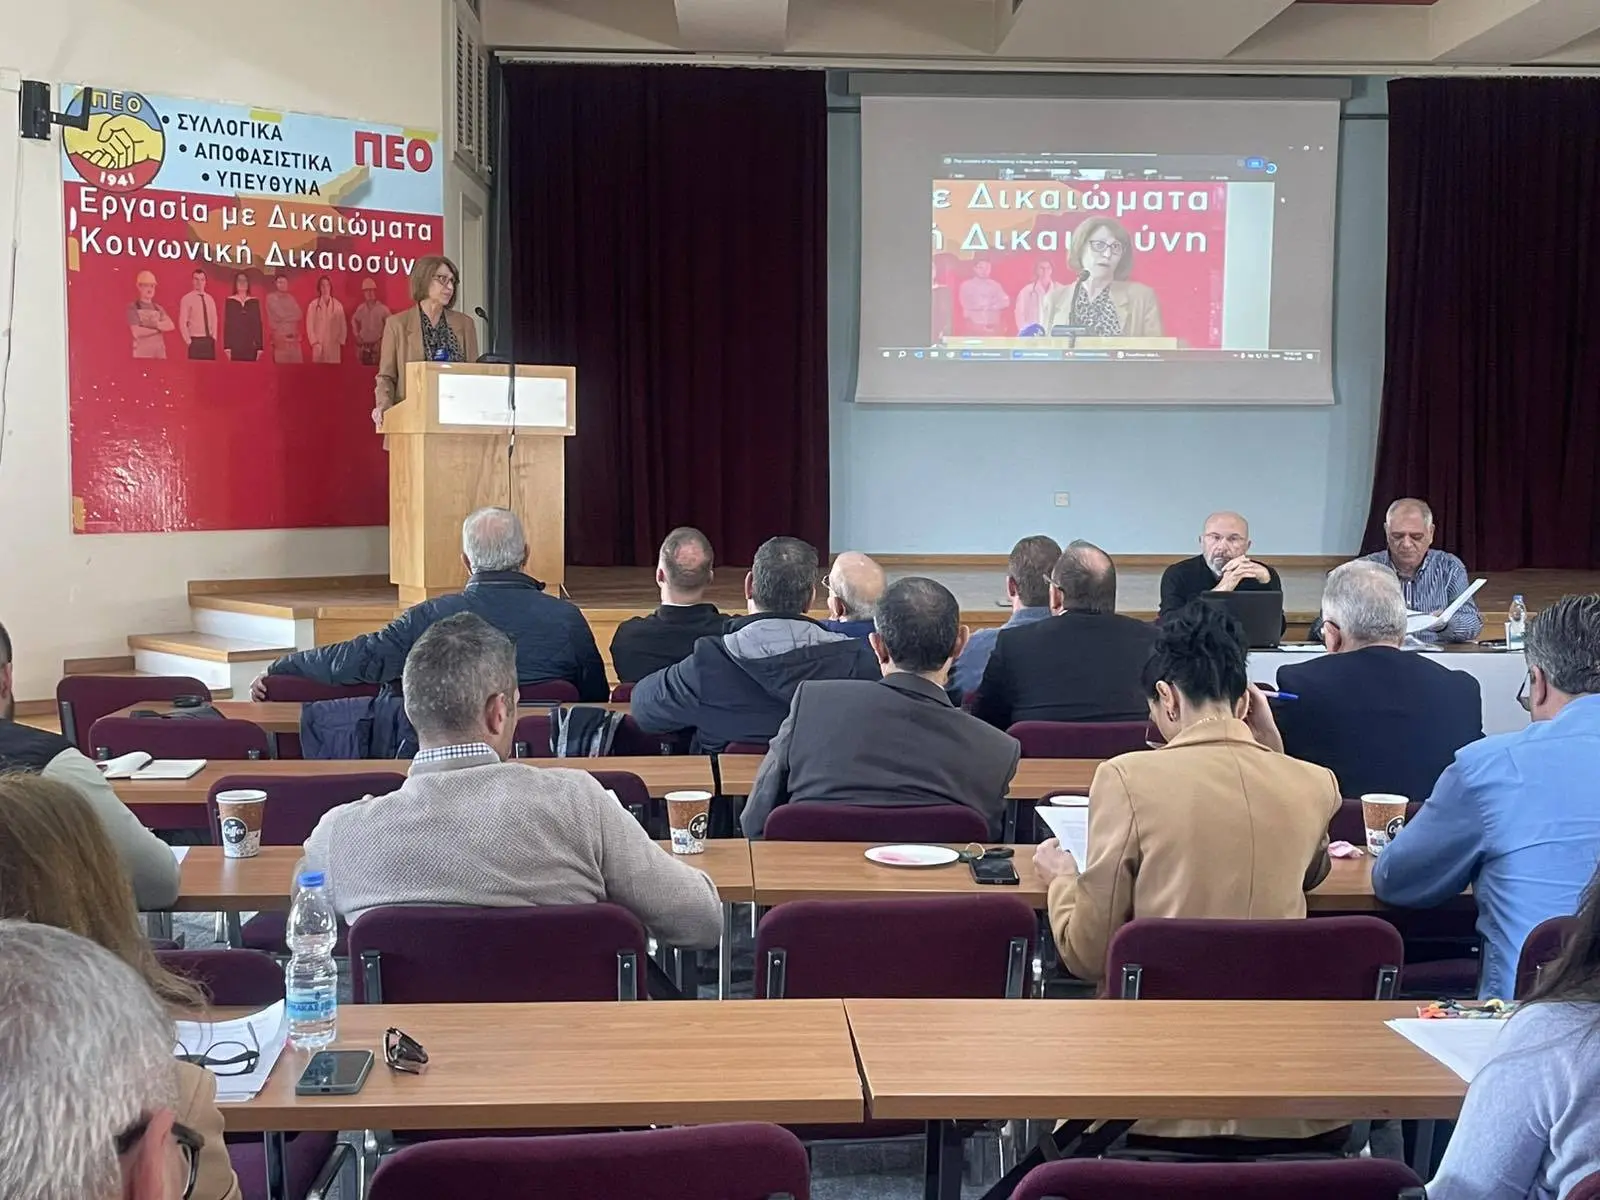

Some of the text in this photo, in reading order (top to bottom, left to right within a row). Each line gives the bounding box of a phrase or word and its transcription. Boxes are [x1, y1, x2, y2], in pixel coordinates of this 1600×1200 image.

[91, 91, 142, 113] ΠΕΟ
[177, 113, 283, 142] ΣΥΛΛΟΓΙΚΑ
[194, 142, 333, 173] ΑΠΟΦΑΣΙΣΤΙΚΑ
[354, 130, 433, 173] ΠΕΟ
[100, 170, 135, 187] 1941
[216, 169, 321, 197] ΥΠΕΥΘΥΝΑ
[79, 186, 432, 243] Εργασία με Δικαιώματα
[967, 182, 1209, 217] Δικαιώματα
[80, 226, 416, 277] Κοινωνική Δικαιοσύν
[960, 221, 1207, 253] Δικαιύνη
